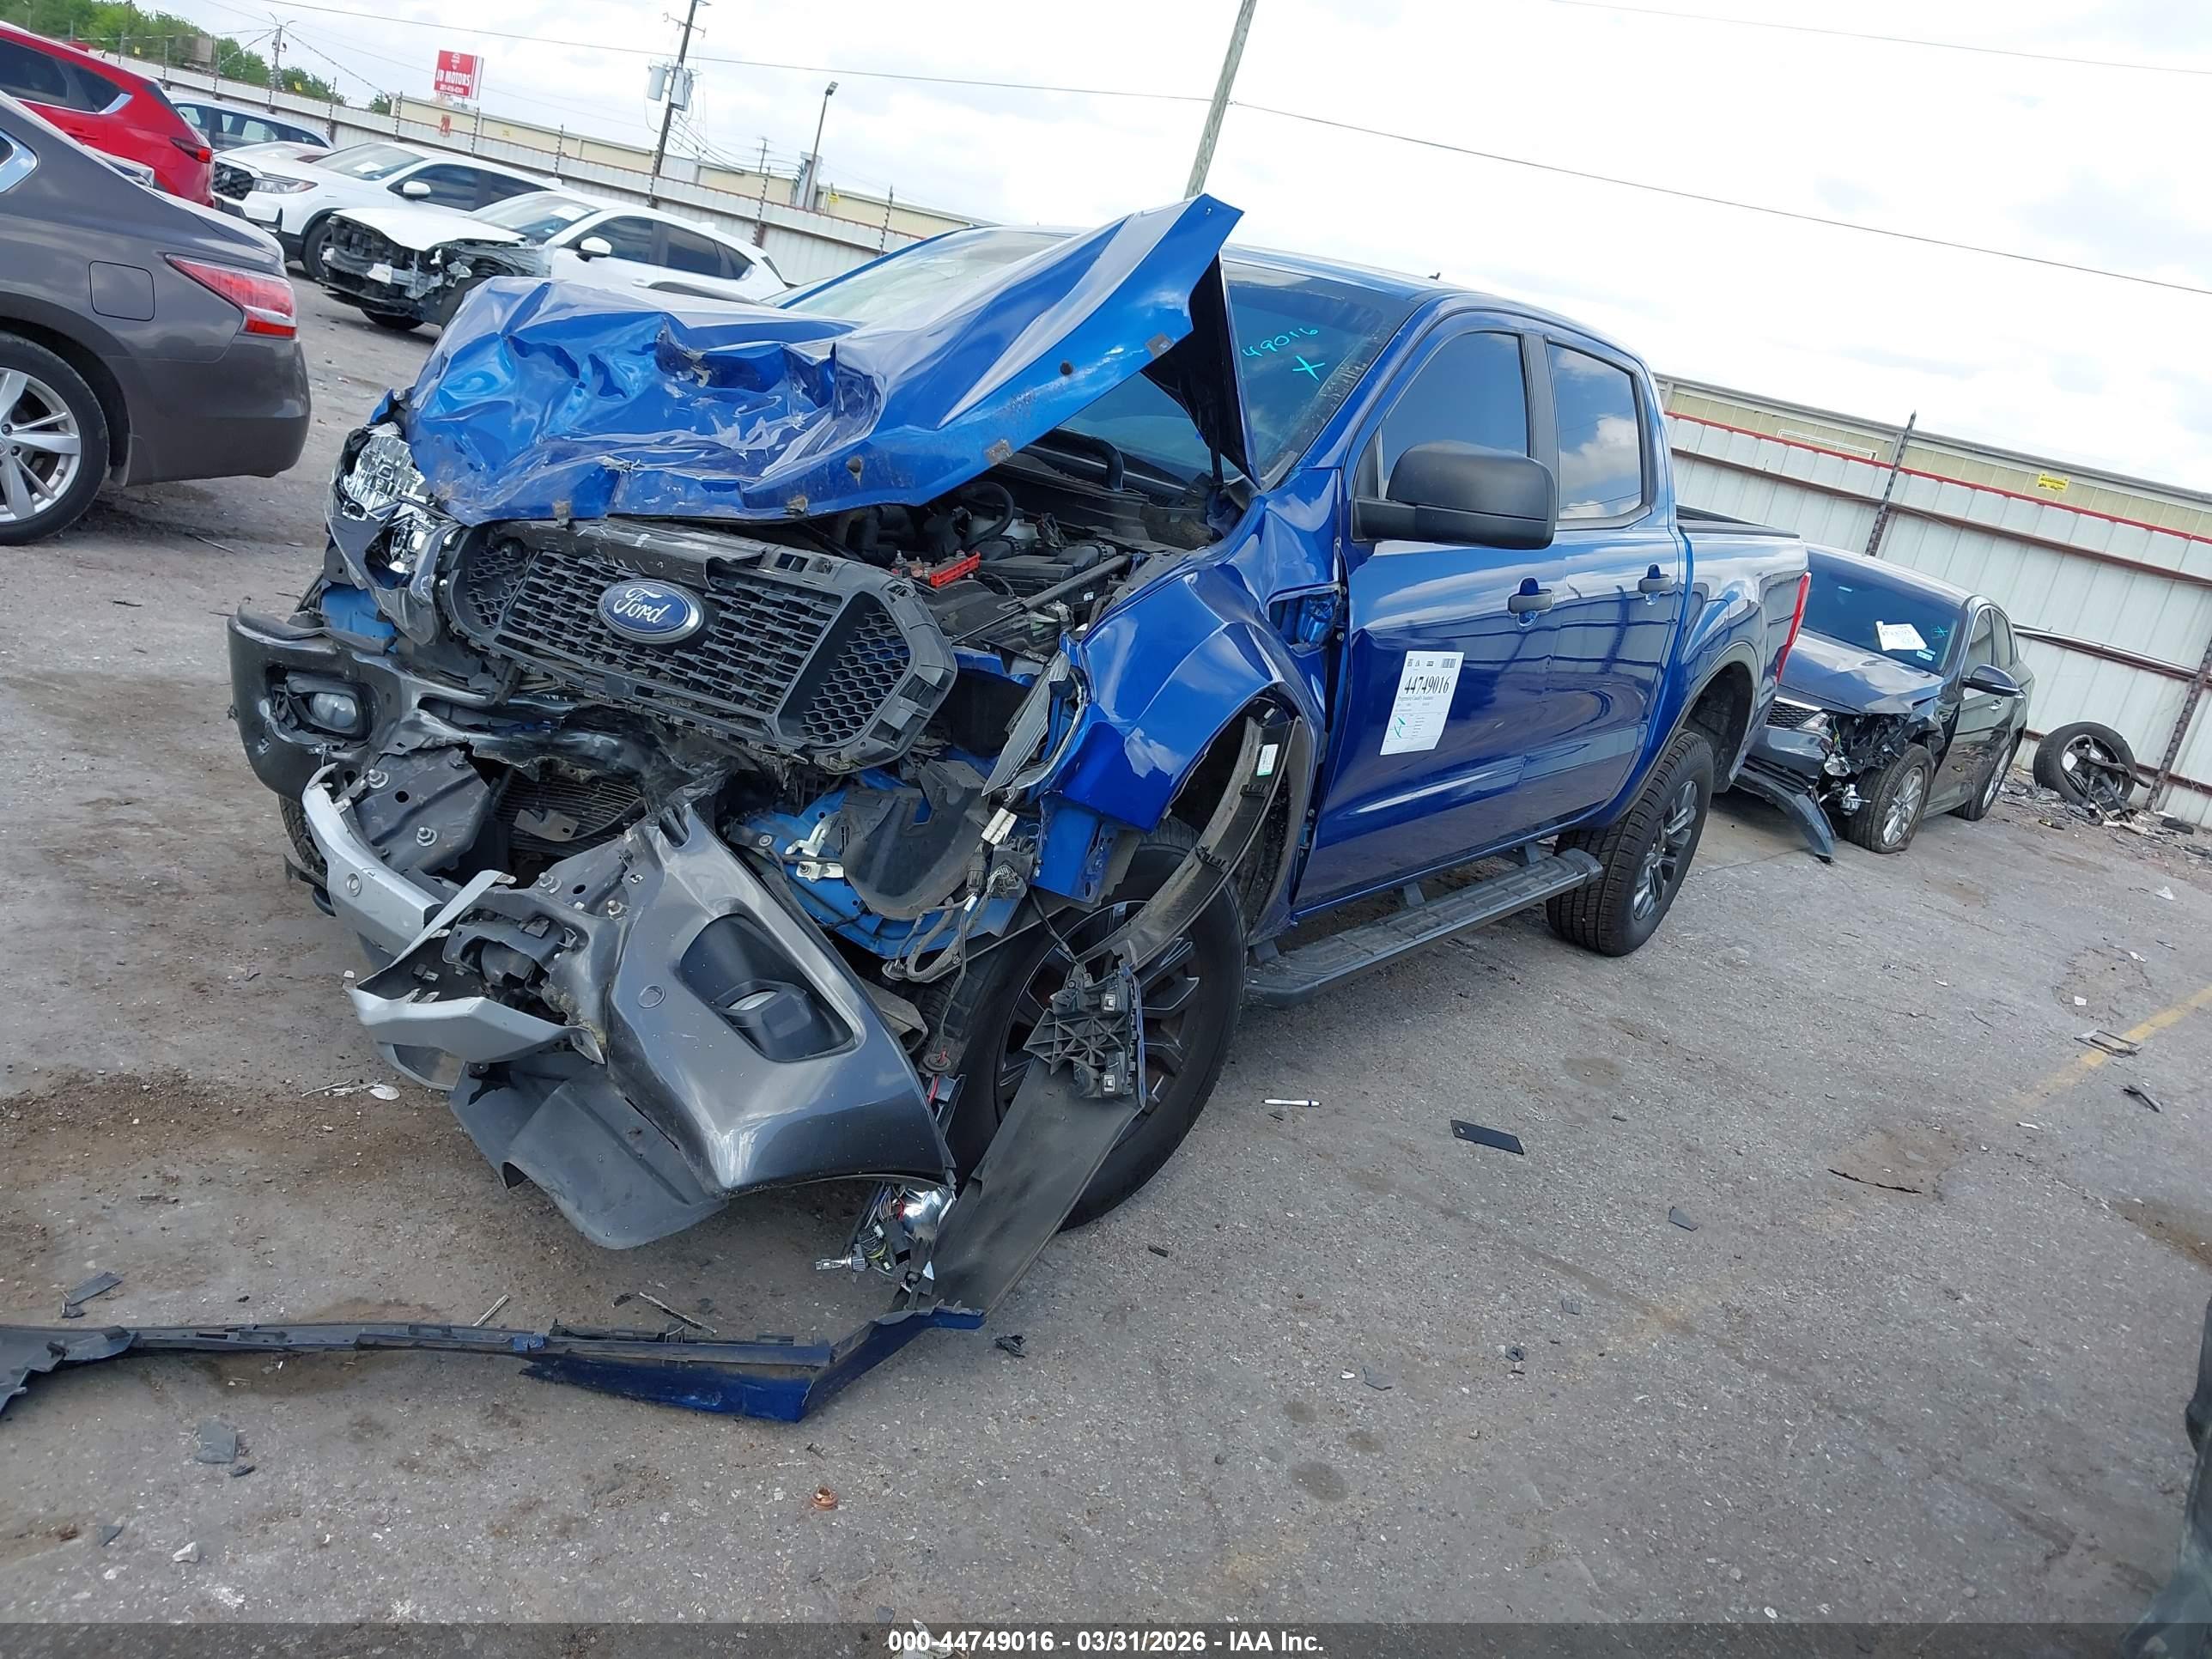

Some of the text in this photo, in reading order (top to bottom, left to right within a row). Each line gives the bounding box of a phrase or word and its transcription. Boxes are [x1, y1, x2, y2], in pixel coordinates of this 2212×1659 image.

[436, 69, 471, 87] JB MOTORS
[1242, 327, 1319, 357] 49016
[613, 587, 672, 623] Ford
[1404, 676, 1451, 695] 44749016
